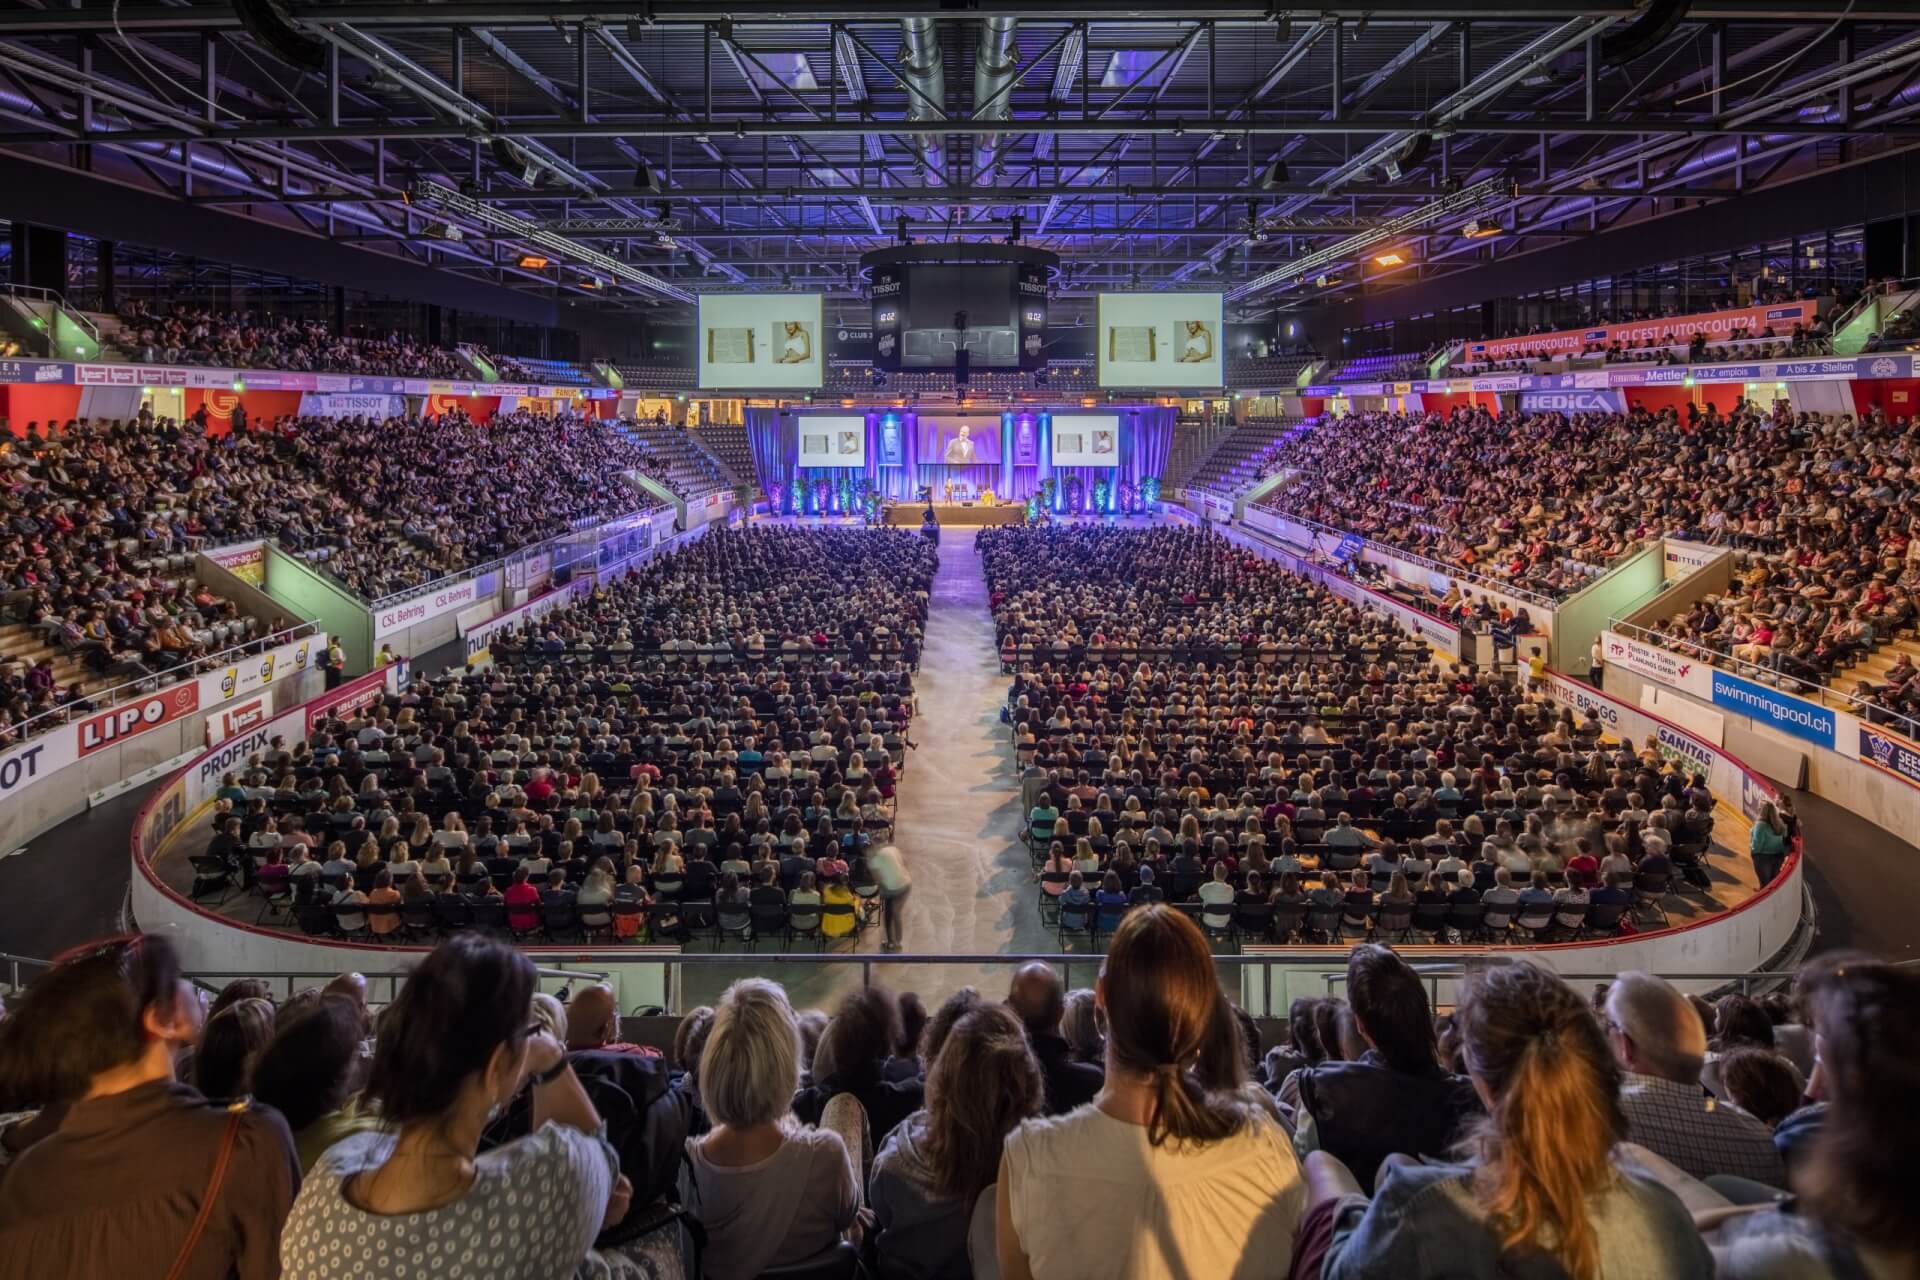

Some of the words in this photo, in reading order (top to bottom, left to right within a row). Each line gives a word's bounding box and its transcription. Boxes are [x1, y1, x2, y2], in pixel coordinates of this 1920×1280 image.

[873, 282, 901, 294] TISSOT
[1019, 282, 1047, 293] TISSOT
[1632, 327, 1659, 339] C'EST
[1663, 316, 1756, 337] AUTOSCOUT24
[1520, 336, 1579, 351] AUTOSCOUT24
[1645, 369, 1687, 381] Mettler
[1719, 368, 1748, 379] emplois
[1822, 362, 1854, 372] Stellen
[345, 397, 382, 408] TISSOT
[435, 596, 448, 608] CSL
[448, 587, 472, 603] Behring
[382, 615, 396, 628] CSL
[397, 604, 425, 621] Behring
[1541, 680, 1575, 704] ENTRE
[1715, 682, 1832, 735] swimmingpool.ch
[84, 700, 165, 750] LIPO
[201, 729, 268, 783] PROFFIX
[1659, 729, 1712, 766] SANITAS
[1899, 750, 1920, 772] SEE
